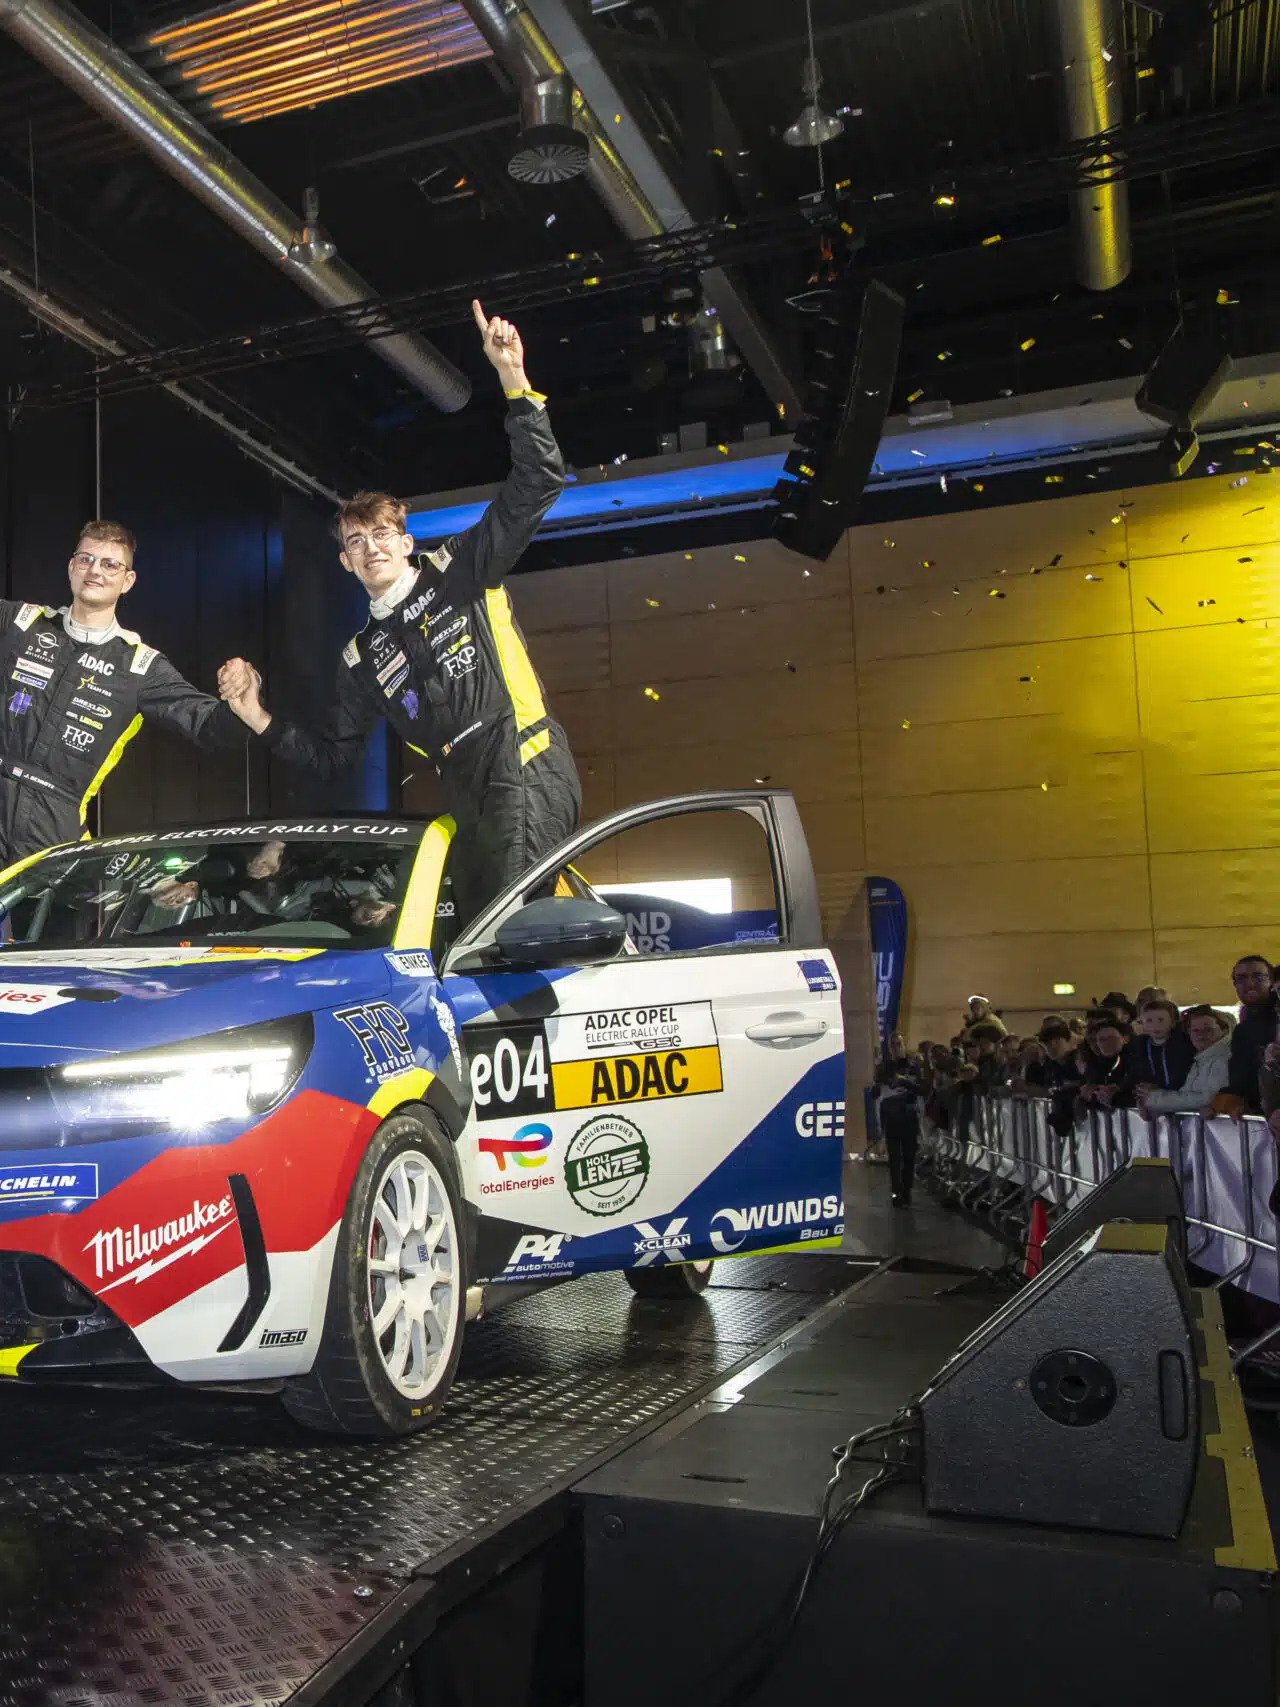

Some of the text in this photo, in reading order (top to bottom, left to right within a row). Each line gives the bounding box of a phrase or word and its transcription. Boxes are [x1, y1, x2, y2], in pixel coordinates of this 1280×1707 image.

[403, 587, 436, 624] ADAC
[27, 645, 55, 659] OPEL
[373, 642, 395, 665] OPEL
[443, 645, 476, 678] FKP
[77, 652, 115, 676] ADAC
[87, 683, 102, 694] TEAM
[72, 696, 108, 714] DREXLER
[62, 724, 95, 746] FKP
[101, 834, 157, 848] OPEL
[158, 825, 267, 841] ELECTRIC
[268, 824, 349, 834] RALLY
[352, 825, 409, 835] CUP
[584, 1007, 678, 1031] ADAC OPEL
[332, 1000, 413, 1067] FKP
[585, 1024, 680, 1043] ELECTRIC RALLY CUP
[470, 1035, 549, 1106] e04
[590, 1052, 689, 1104] ADAC
[576, 1123, 633, 1152] FAMILIENBETRIEB
[586, 1153, 612, 1168] HOLZ
[480, 1175, 555, 1196] TotalEnergies
[597, 1195, 626, 1209] SEIT 1935
[634, 1235, 691, 1252] X-CLEAN
[799, 1228, 829, 1240] Bau
[515, 1260, 575, 1273] automotive
